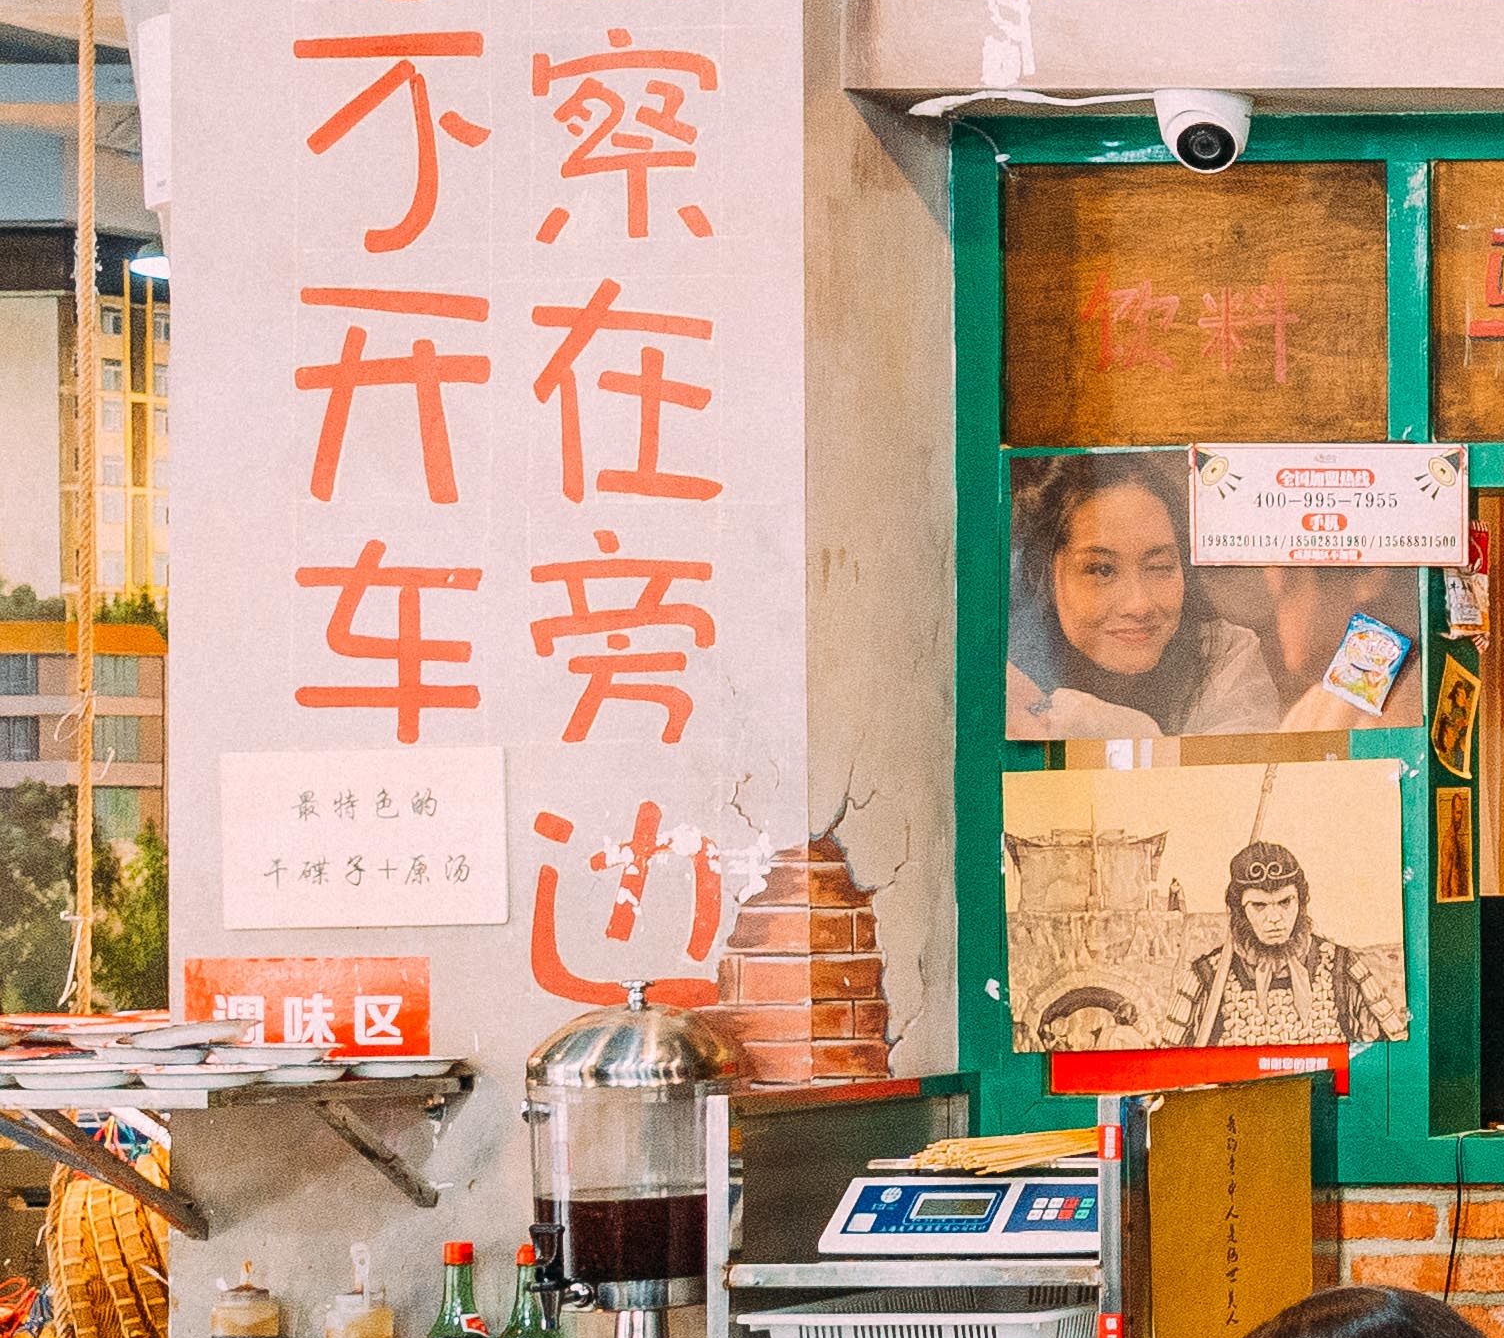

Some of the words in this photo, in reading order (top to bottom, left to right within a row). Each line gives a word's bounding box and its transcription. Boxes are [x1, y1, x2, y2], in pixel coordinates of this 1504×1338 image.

[1254, 492, 1398, 509] 400-995-7955
[292, 788, 440, 822] 最特色的
